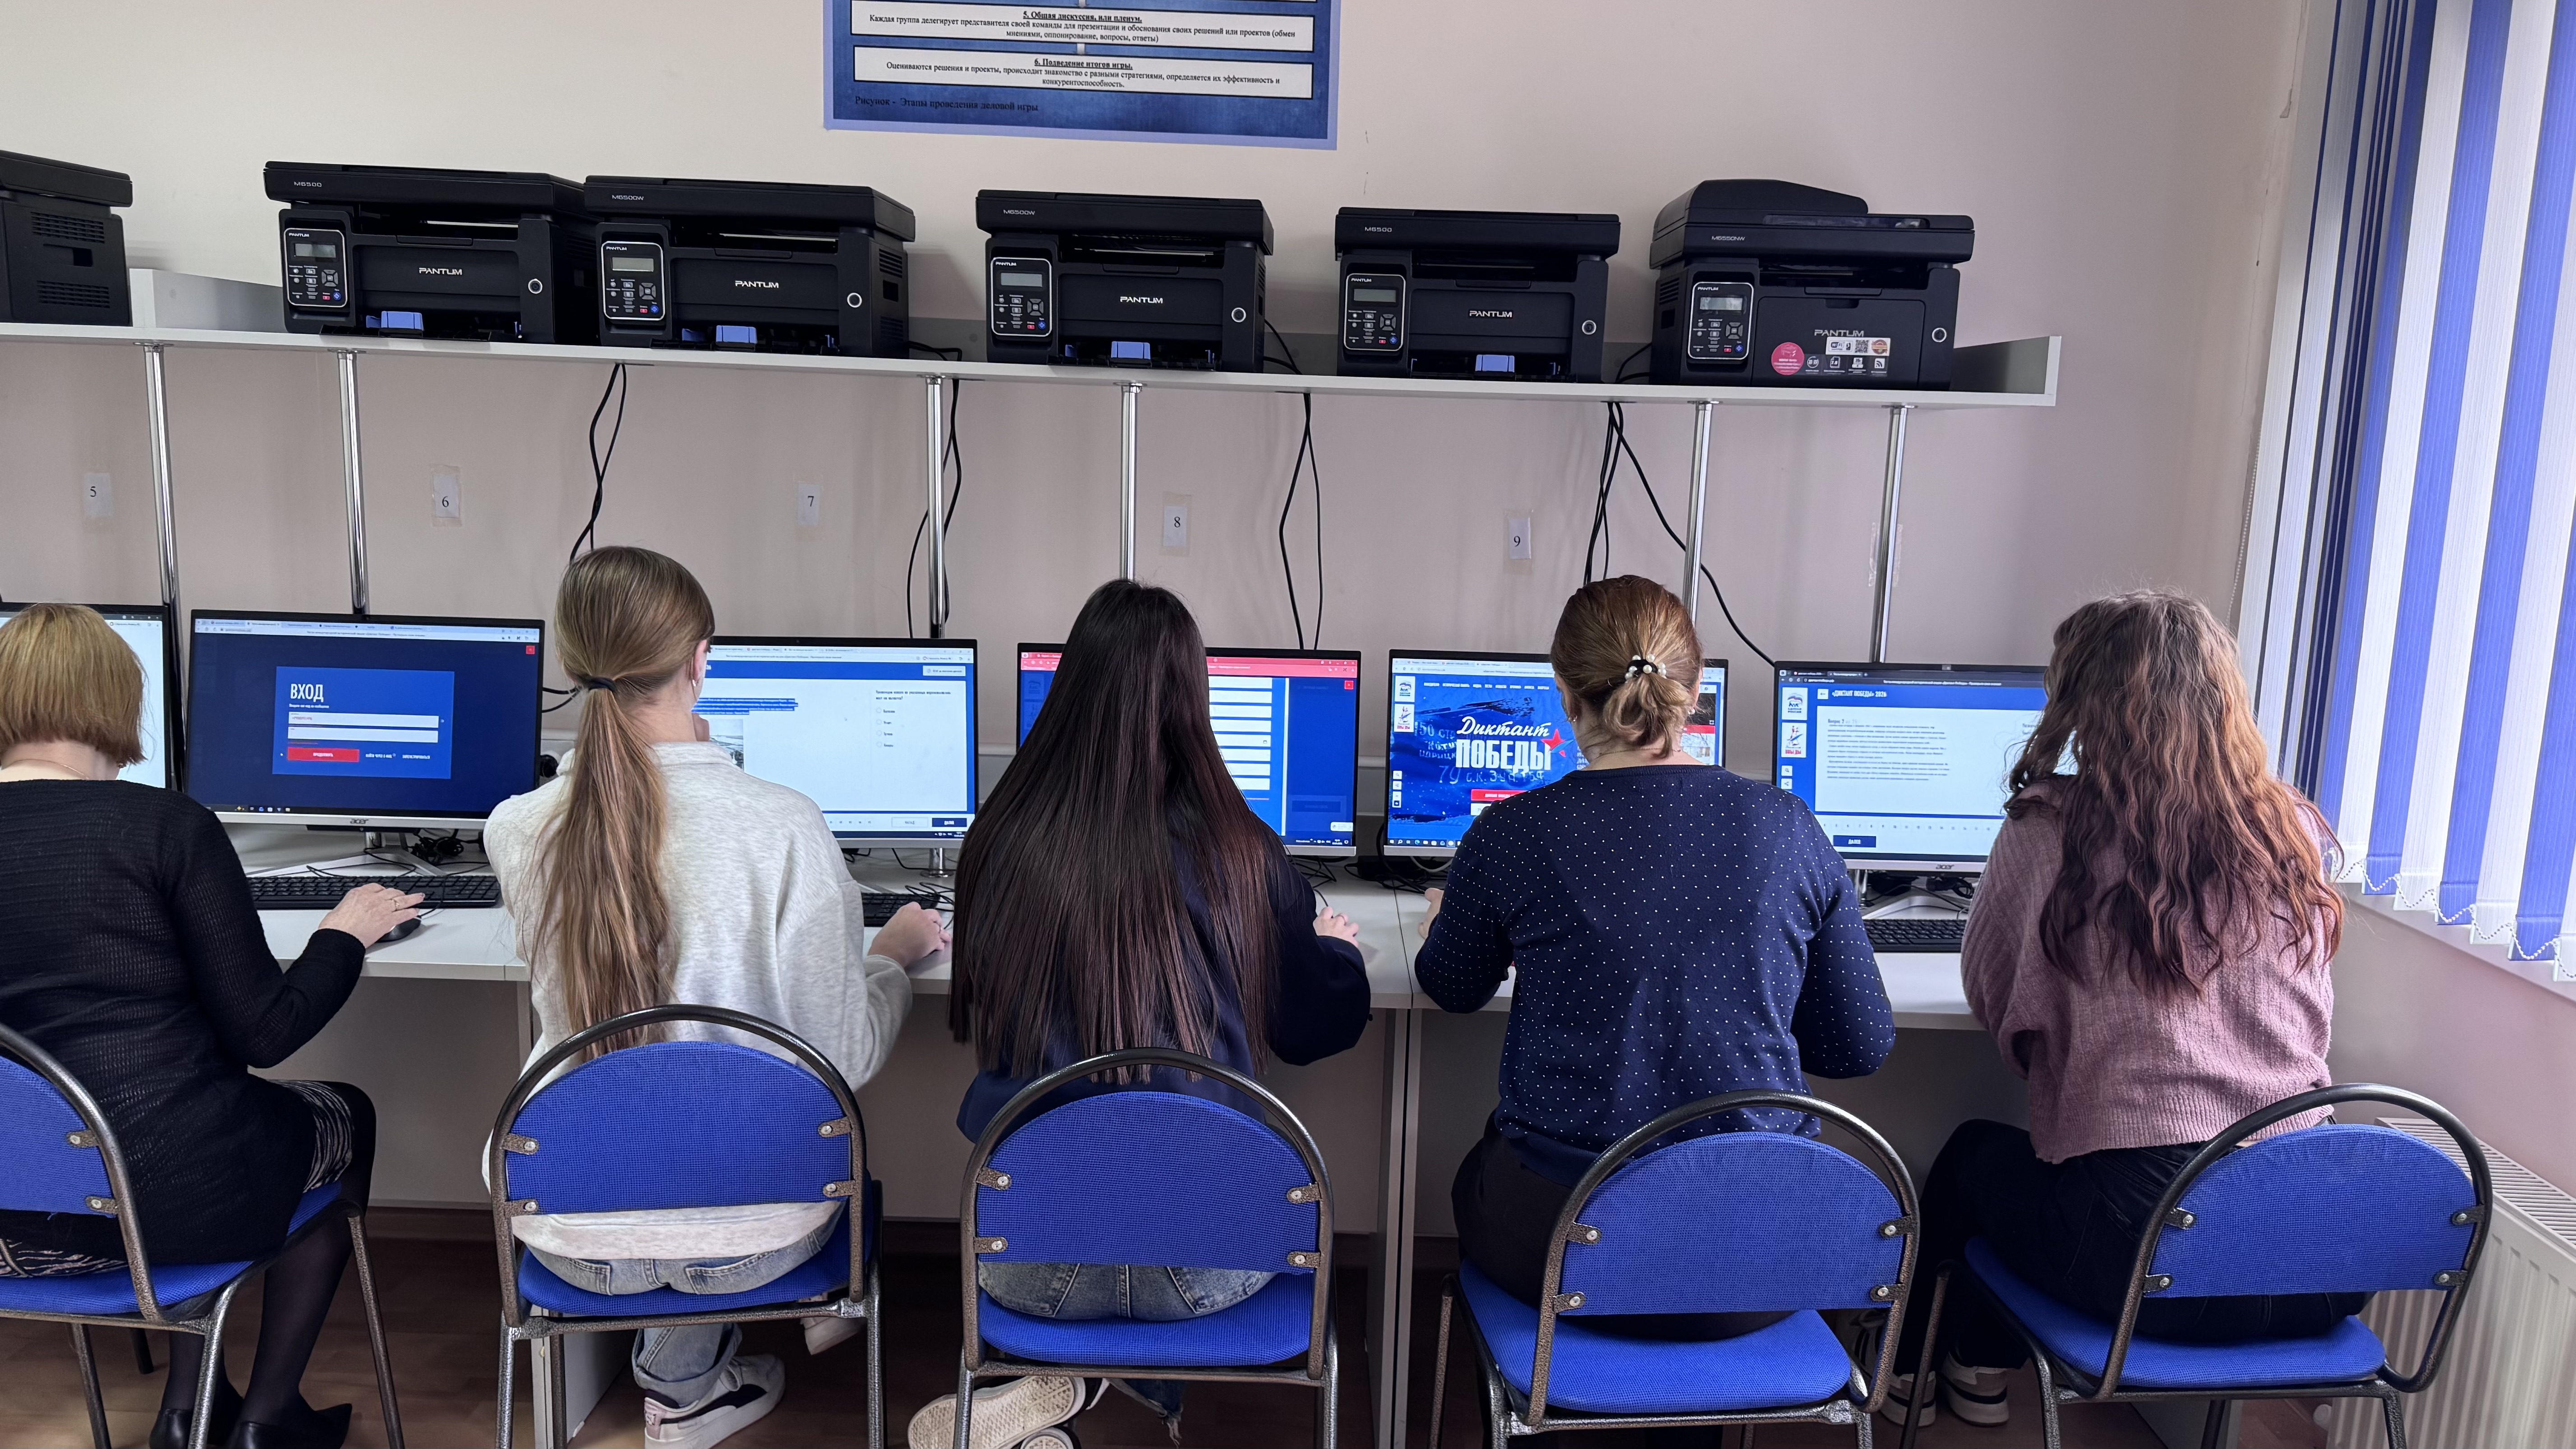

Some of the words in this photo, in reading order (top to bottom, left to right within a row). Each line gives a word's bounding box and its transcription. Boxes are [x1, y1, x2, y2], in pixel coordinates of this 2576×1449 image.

[1031, 11, 1056, 19] Общая
[1132, 35, 1158, 43] ответы)
[1272, 30, 1295, 38] (обмен
[1043, 59, 1084, 67] Подведение
[887, 62, 932, 70] Оцениваются
[1223, 76, 1274, 84] эффективность
[856, 96, 890, 106] Рисунок
[900, 98, 927, 107] Этапы
[930, 100, 978, 109] проведения
[1017, 105, 1038, 113] игры
[91, 486, 96, 497] 5
[442, 497, 449, 507] 6
[808, 496, 814, 506] 7
[1174, 517, 1180, 527] 8
[1514, 536, 1520, 546] 9
[290, 683, 324, 703] ВХОД
[1457, 716, 1551, 737] Диктант
[1456, 739, 1551, 774] ПОБЕДЫ
